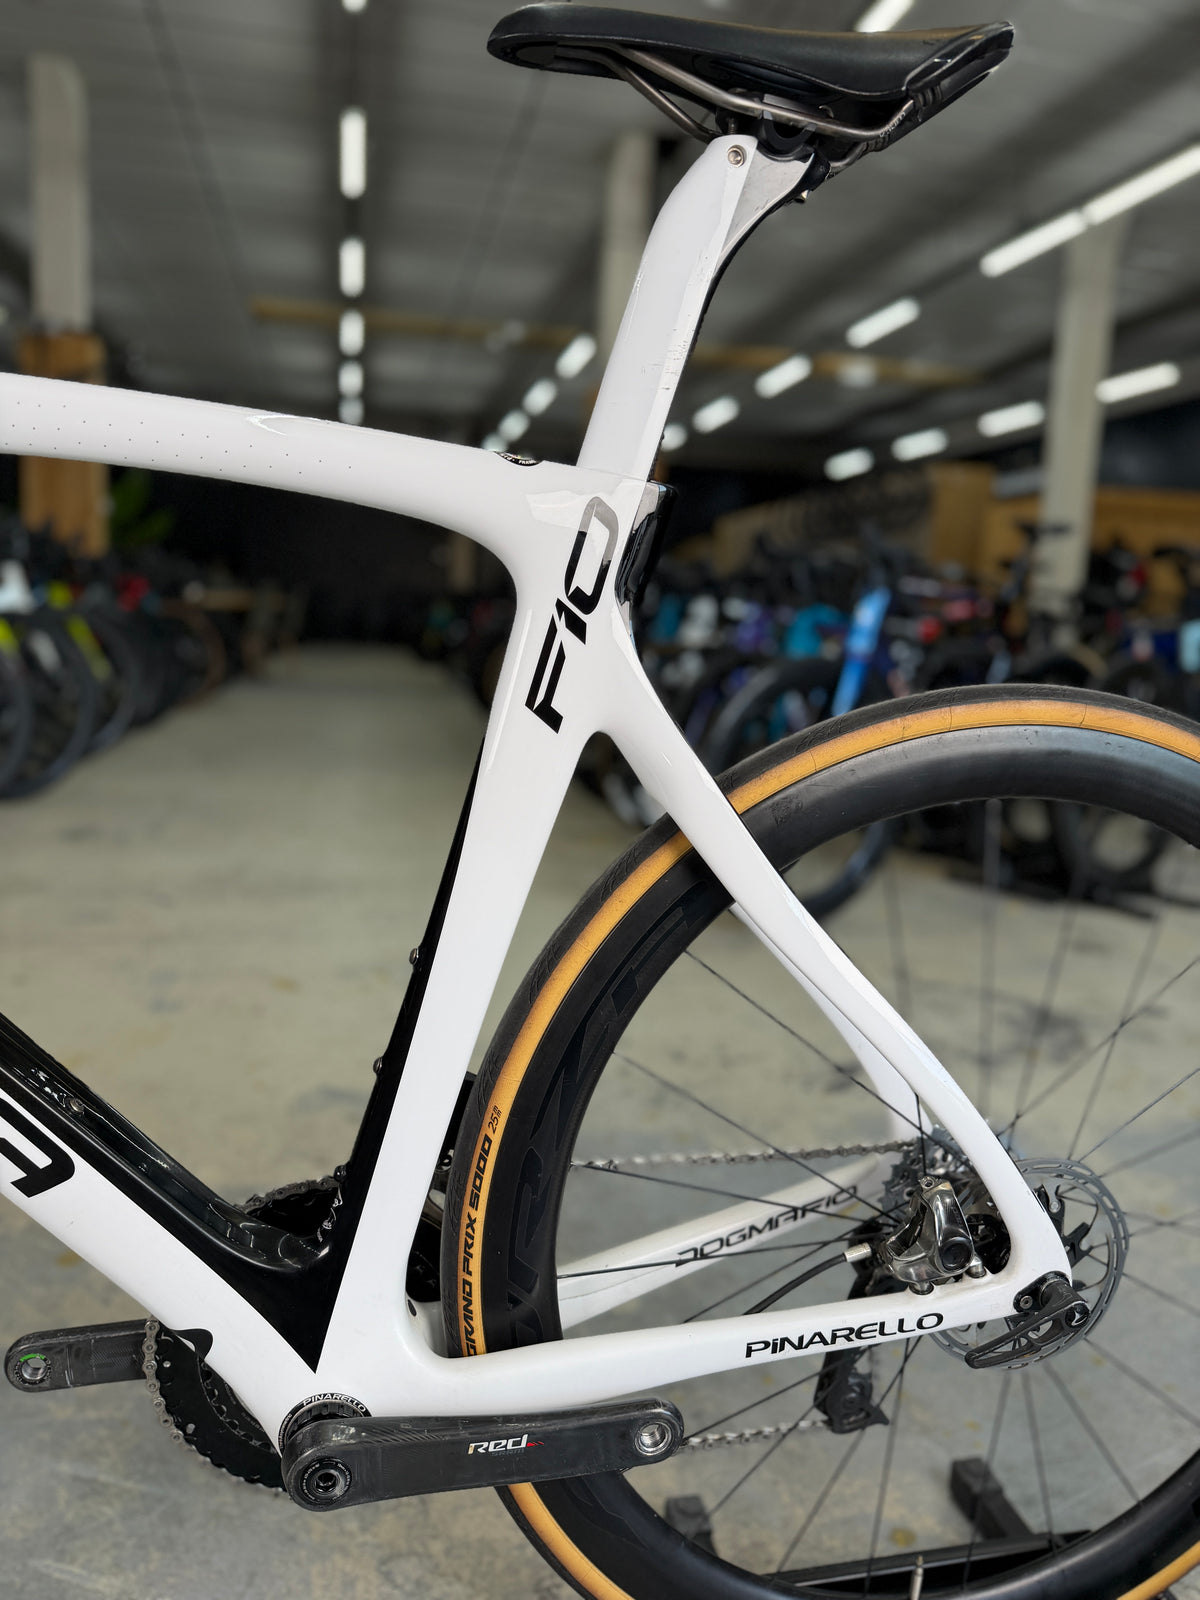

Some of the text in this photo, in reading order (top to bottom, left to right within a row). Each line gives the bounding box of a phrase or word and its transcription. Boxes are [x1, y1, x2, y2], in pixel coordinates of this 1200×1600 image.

[525, 496, 619, 734] F10
[468, 1133, 492, 1212] 5000
[462, 1211, 478, 1279] PRIX
[462, 1278, 478, 1356] GRAND
[302, 1393, 366, 1413] PINARELLO
